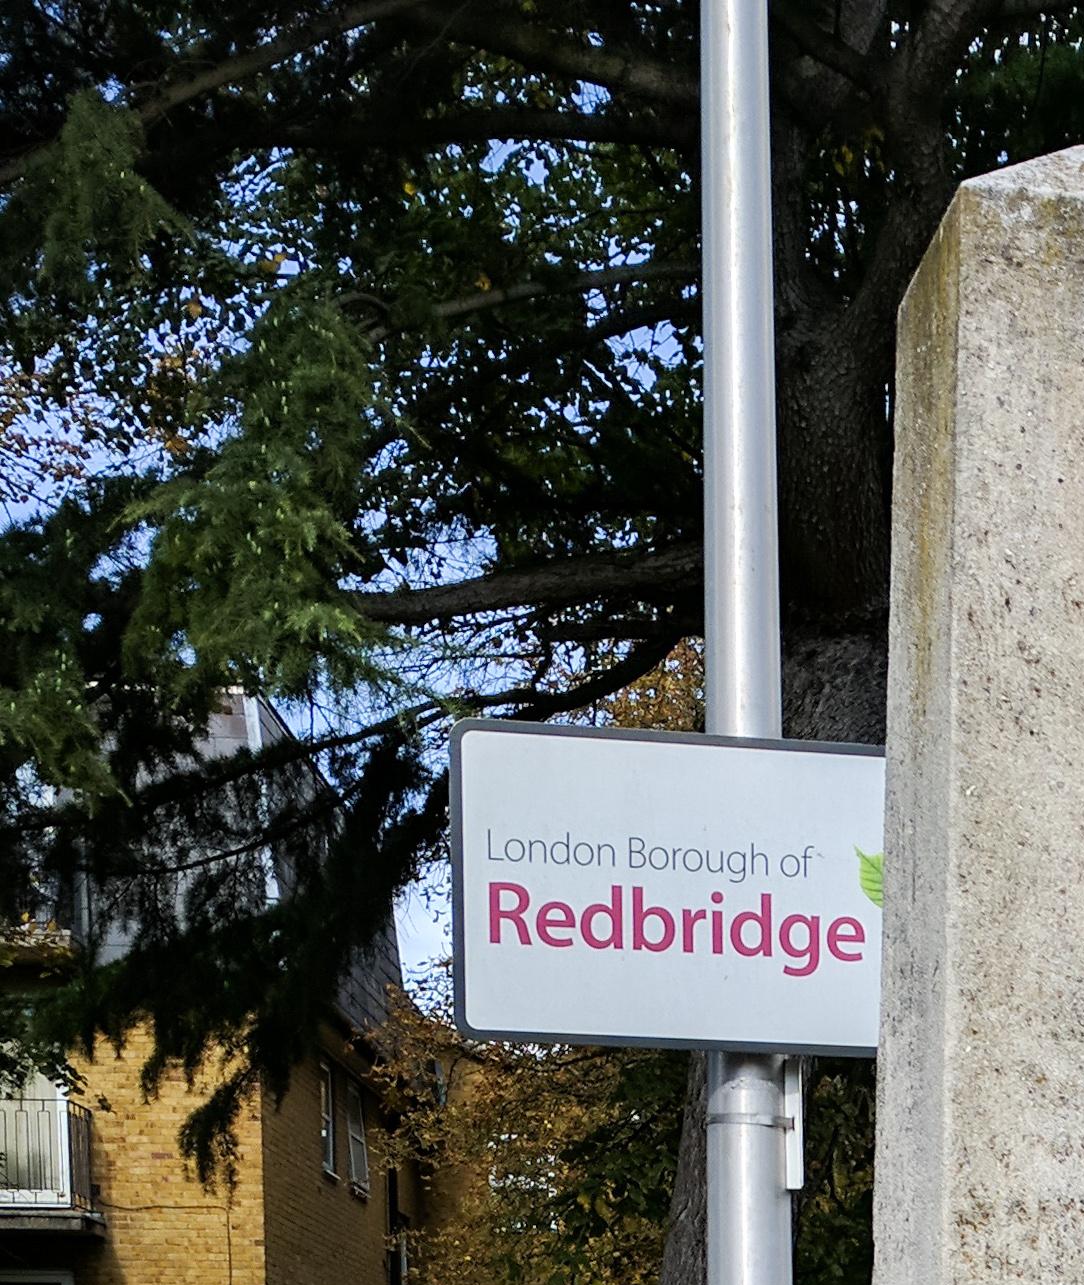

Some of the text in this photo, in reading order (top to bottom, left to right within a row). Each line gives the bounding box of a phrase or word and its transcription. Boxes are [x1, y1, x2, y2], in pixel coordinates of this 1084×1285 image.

[487, 829, 815, 883] London Borough of
[488, 882, 866, 977] Redbridge
